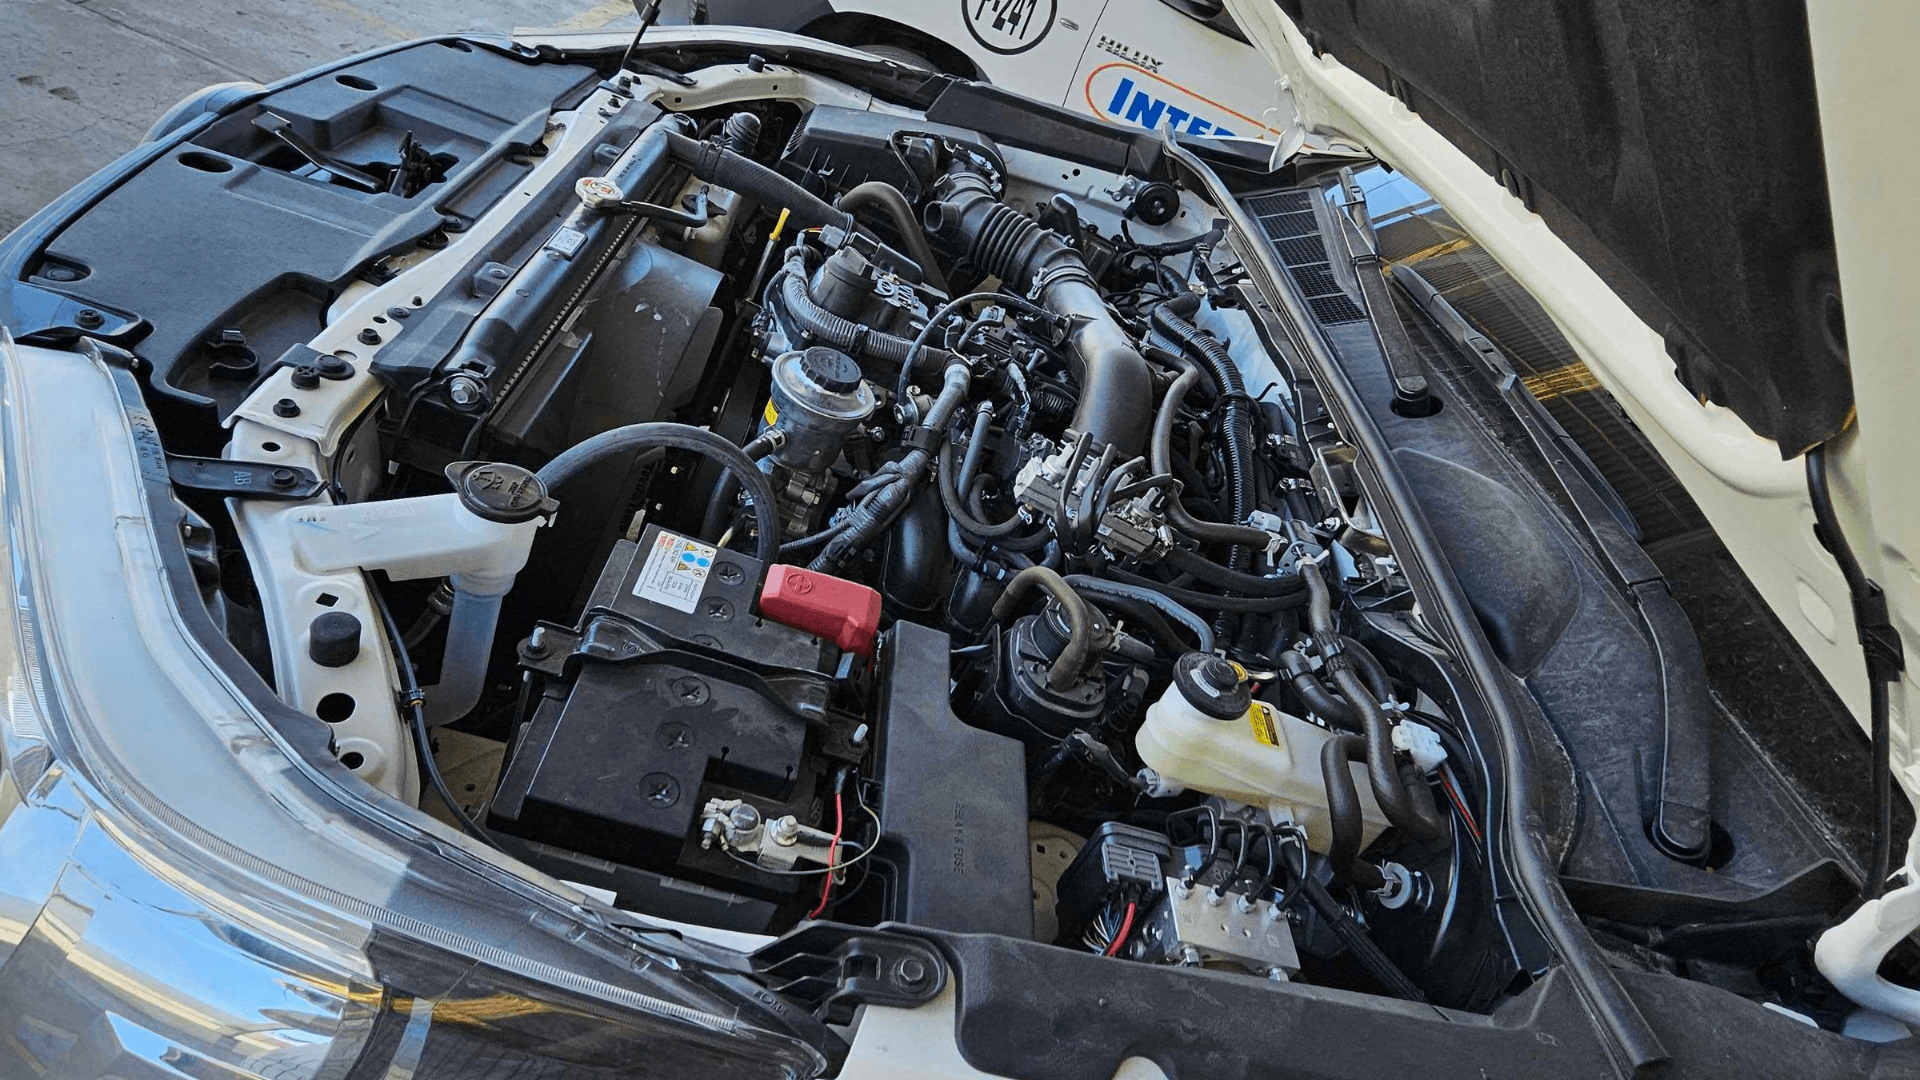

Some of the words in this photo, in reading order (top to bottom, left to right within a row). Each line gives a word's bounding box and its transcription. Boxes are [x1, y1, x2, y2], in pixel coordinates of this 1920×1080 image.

[1096, 35, 1164, 74] HILUX
[1108, 77, 1236, 136] INTE
[233, 470, 253, 486] AB
